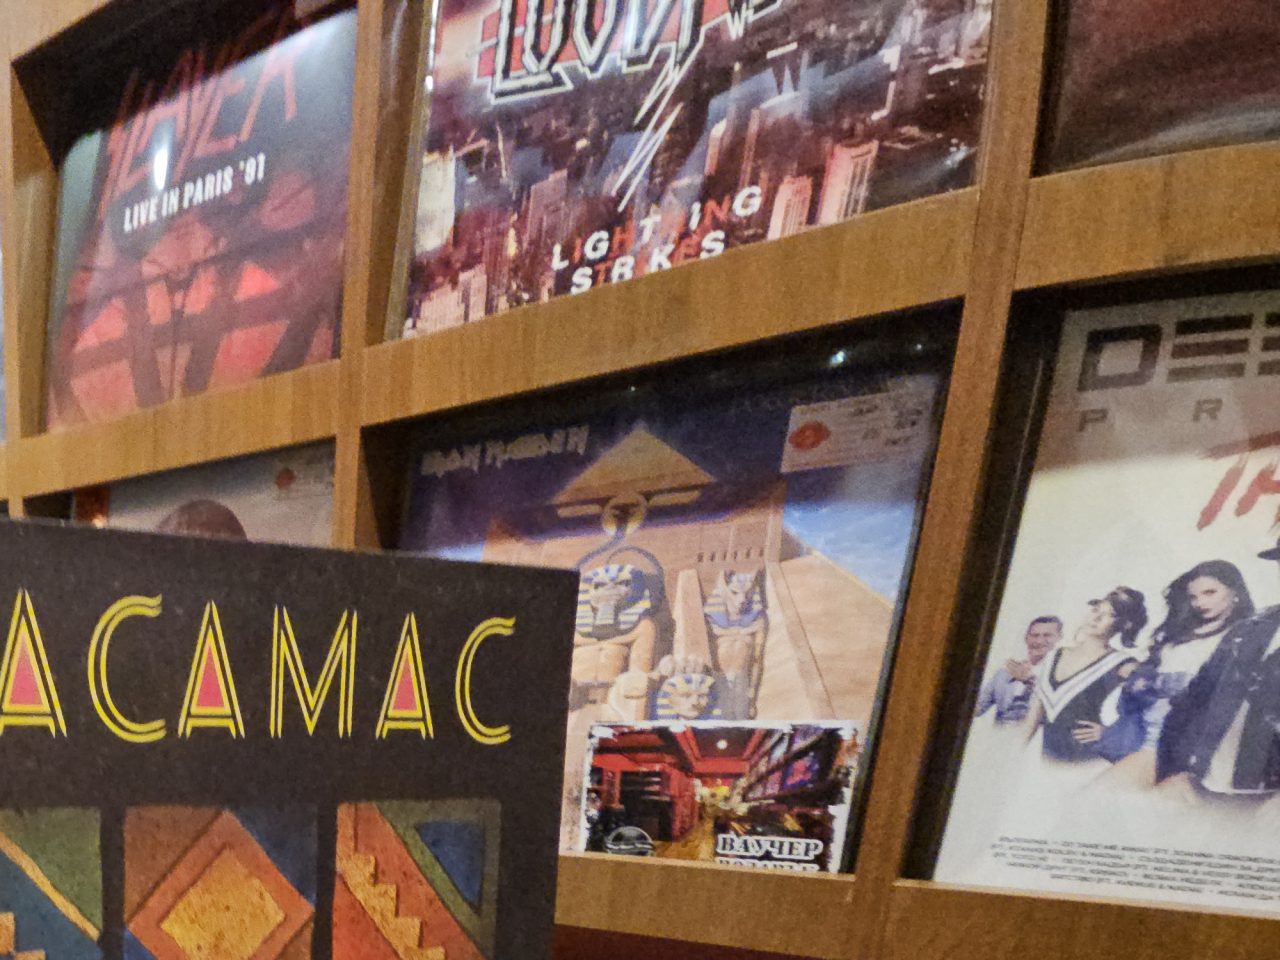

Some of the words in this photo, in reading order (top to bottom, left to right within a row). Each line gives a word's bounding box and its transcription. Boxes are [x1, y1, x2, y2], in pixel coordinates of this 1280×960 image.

[124, 195, 158, 233] LIVE
[161, 187, 180, 218] IN
[183, 165, 234, 210] PARIS
[238, 152, 267, 186] '91
[570, 230, 727, 296] STRIKES
[720, 835, 821, 859] ВАУЧЕР
